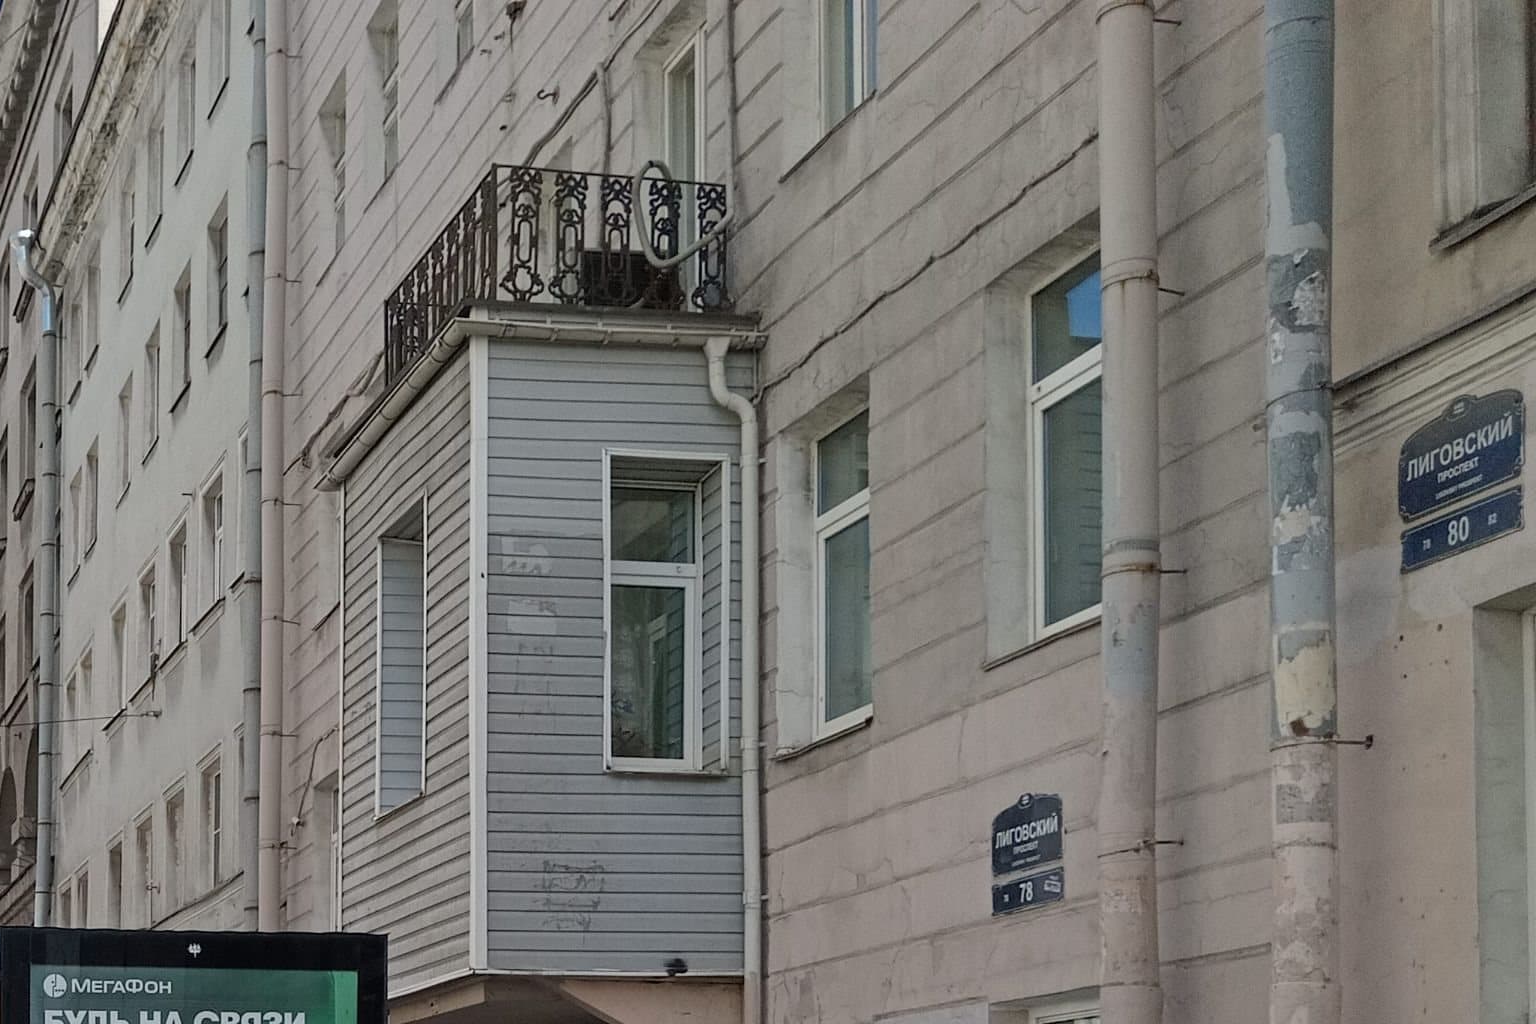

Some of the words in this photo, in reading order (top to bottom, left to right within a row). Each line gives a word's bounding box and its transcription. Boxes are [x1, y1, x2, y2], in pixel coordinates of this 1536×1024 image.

[1407, 411, 1513, 482] ЛИГОВСКИЙ
[1437, 456, 1479, 484] ПРОСПЕКТ
[1447, 516, 1469, 546] 80
[995, 812, 1058, 849] ЛИГОВСКИЙ
[1019, 881, 1033, 903] 78
